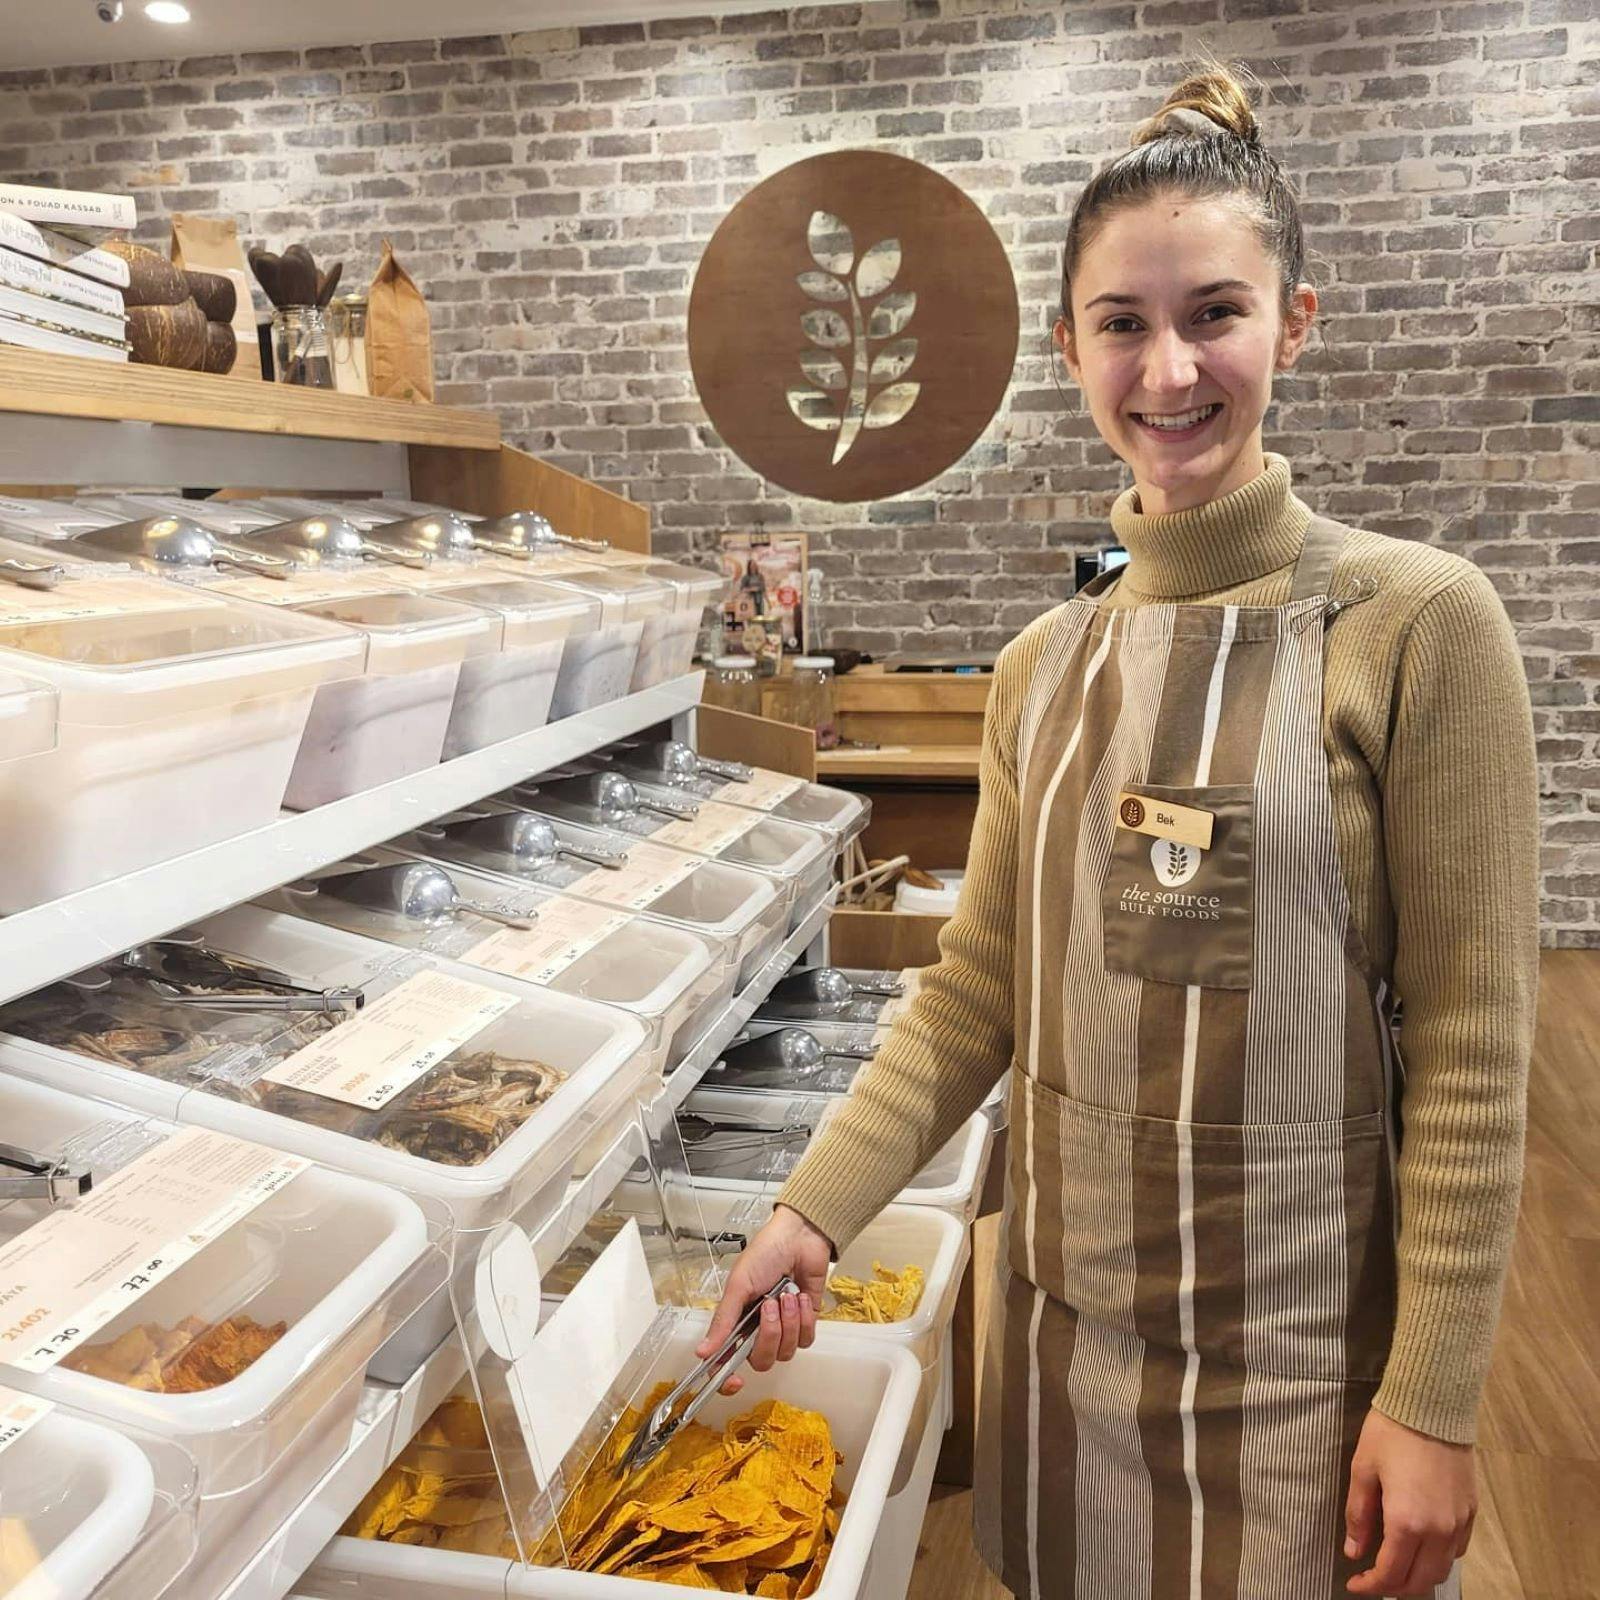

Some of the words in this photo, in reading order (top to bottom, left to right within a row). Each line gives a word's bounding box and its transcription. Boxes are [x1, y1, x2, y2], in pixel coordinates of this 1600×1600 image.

[27, 198, 61, 210] FOUAD
[1156, 813, 1175, 827] Bek
[1122, 883, 1150, 902] the
[1153, 891, 1220, 908] source
[1120, 901, 1156, 916] BULK
[1162, 907, 1220, 921] FOODS
[120, 1259, 162, 1291] 77.00
[1, 1308, 51, 1341] 21402
